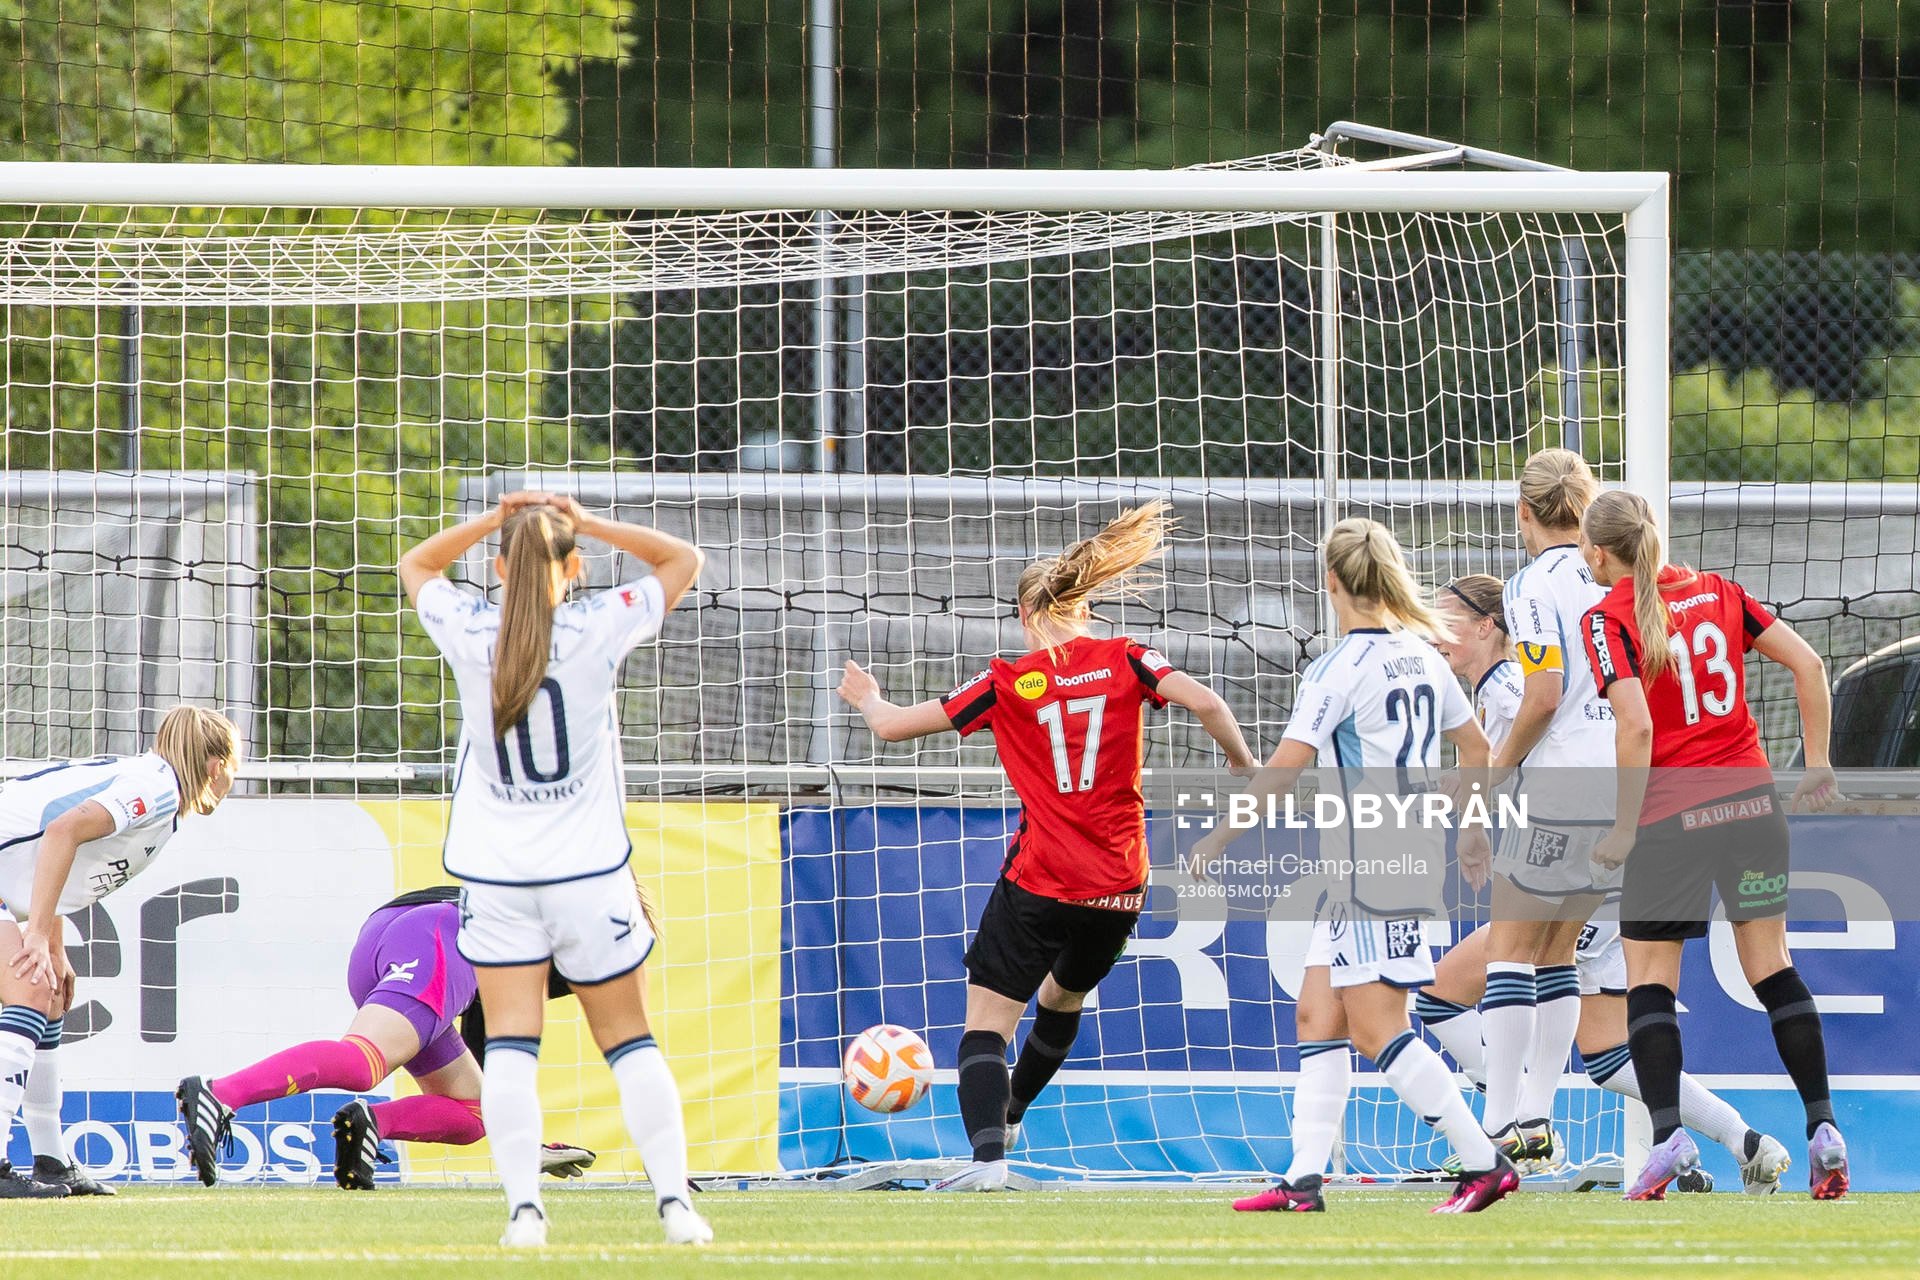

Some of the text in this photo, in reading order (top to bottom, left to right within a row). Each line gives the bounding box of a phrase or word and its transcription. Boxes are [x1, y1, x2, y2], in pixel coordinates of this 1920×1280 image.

[1590, 613, 1614, 676] stadium
[1018, 677, 1044, 690] Yale
[1055, 668, 1112, 687] Doorman
[1383, 656, 1426, 682] ALMQVIST
[1669, 621, 1737, 726] 13
[1037, 694, 1107, 793] 17
[1385, 684, 1438, 796] 22
[1684, 796, 1772, 827] BAUHAUS
[1738, 874, 1787, 896] coop
[1741, 870, 1765, 881] Stora
[62, 1119, 322, 1183] OBOS
